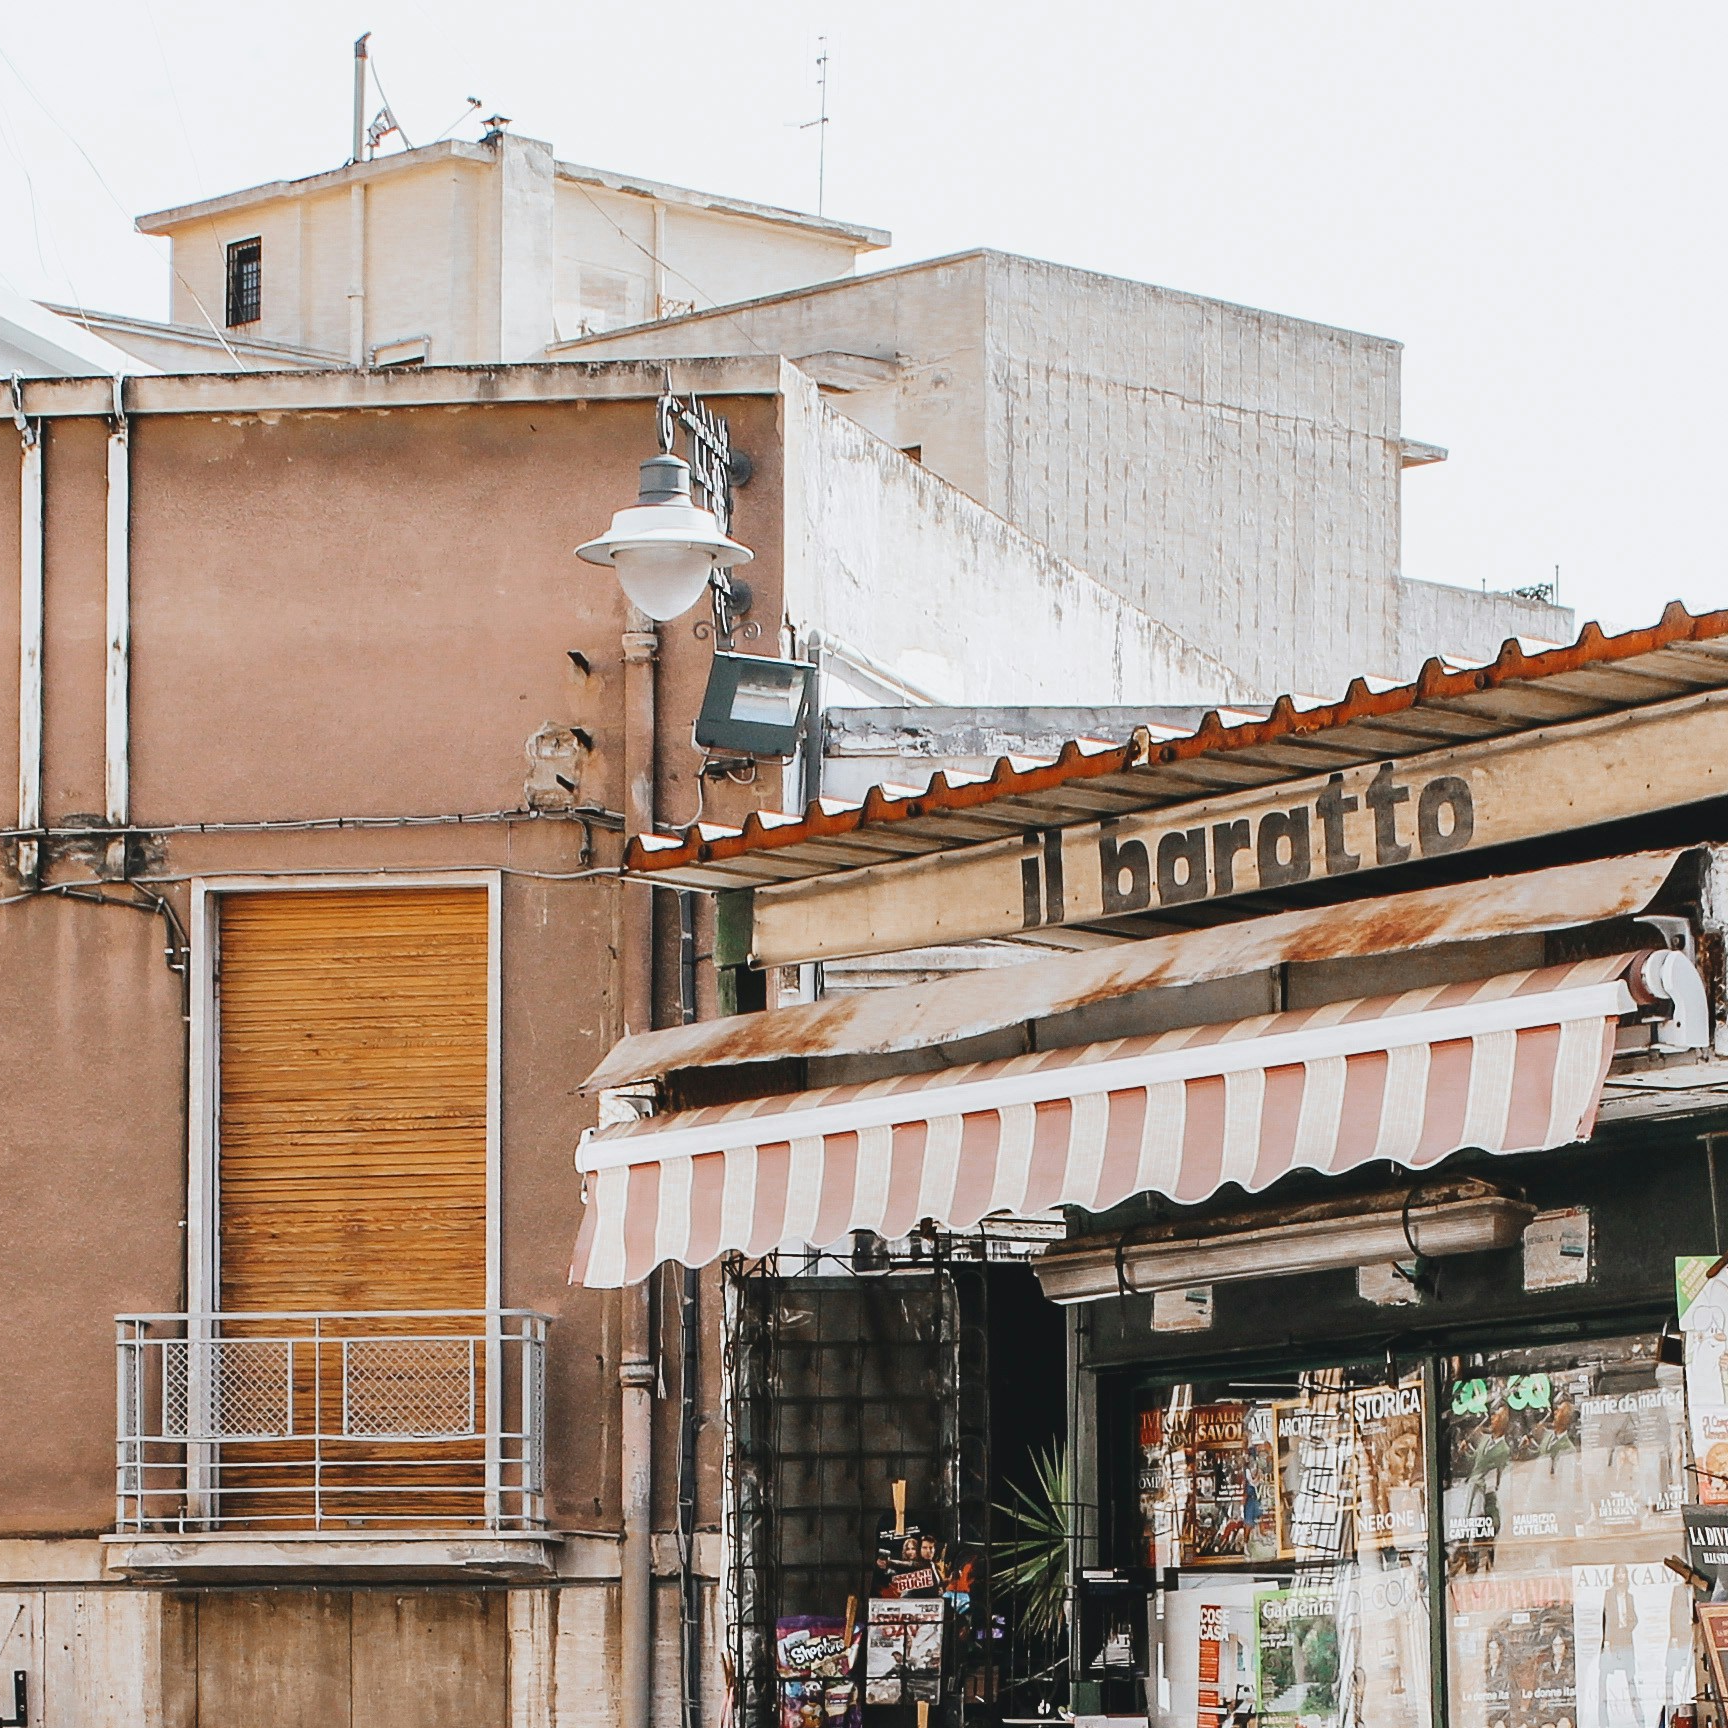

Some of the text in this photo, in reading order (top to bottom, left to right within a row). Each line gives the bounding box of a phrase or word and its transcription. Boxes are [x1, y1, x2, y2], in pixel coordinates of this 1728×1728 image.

[1022, 761, 1476, 929] il baratto
[1354, 1388, 1422, 1422] STORICA
[1580, 1397, 1617, 1417] marie
[1358, 1510, 1416, 1534] NERONE
[1449, 1517, 1493, 1529] MAURIZIO
[1512, 1512, 1556, 1525] MAURIZIO
[1449, 1526, 1495, 1539] CATTELAN
[1513, 1522, 1559, 1536] CATTELAN
[1689, 1525, 1703, 1546] LA
[898, 1576, 934, 1592] BUGIE
[1200, 1608, 1230, 1625] COSE
[1262, 1600, 1334, 1620] Gardenia
[1199, 1625, 1230, 1642] CASA
